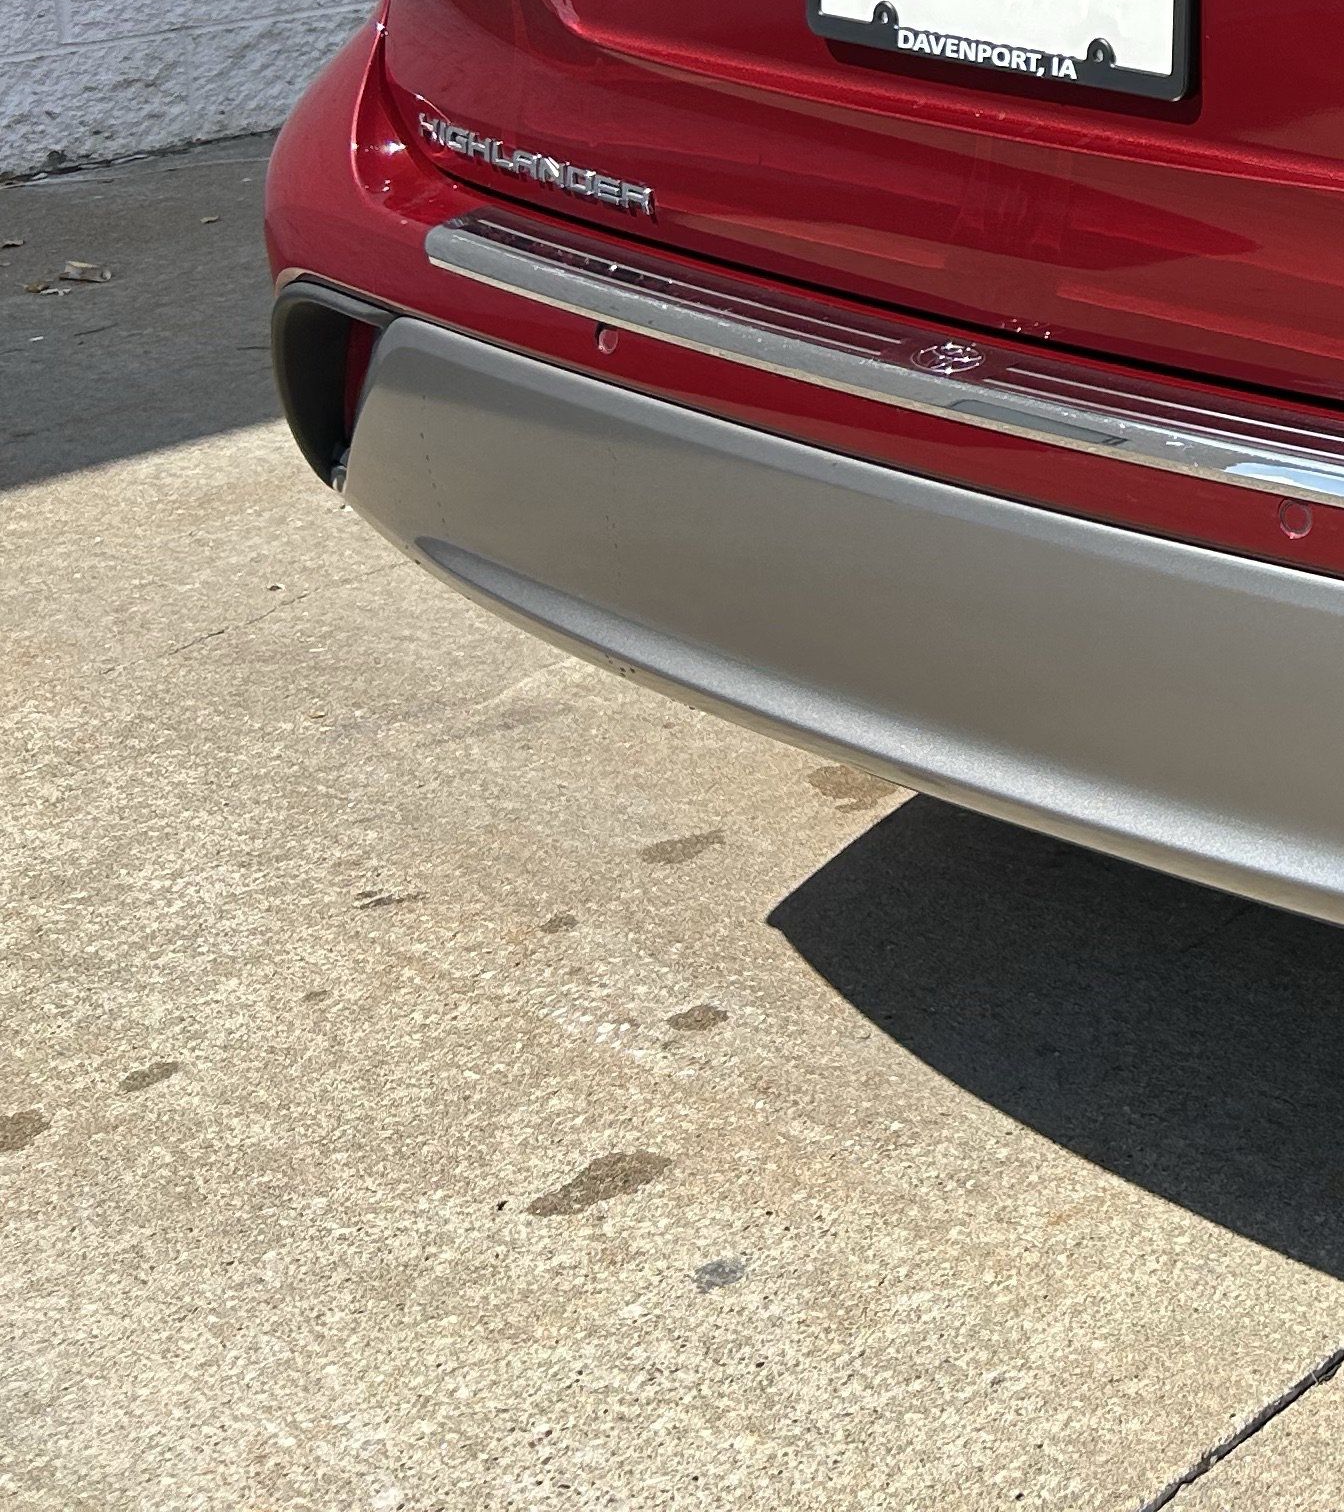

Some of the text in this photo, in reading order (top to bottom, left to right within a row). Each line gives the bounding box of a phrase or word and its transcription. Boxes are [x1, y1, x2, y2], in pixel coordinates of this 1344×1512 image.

[897, 27, 1078, 80] DAVENPORT, IA
[418, 112, 656, 218] HIGHLANDER
